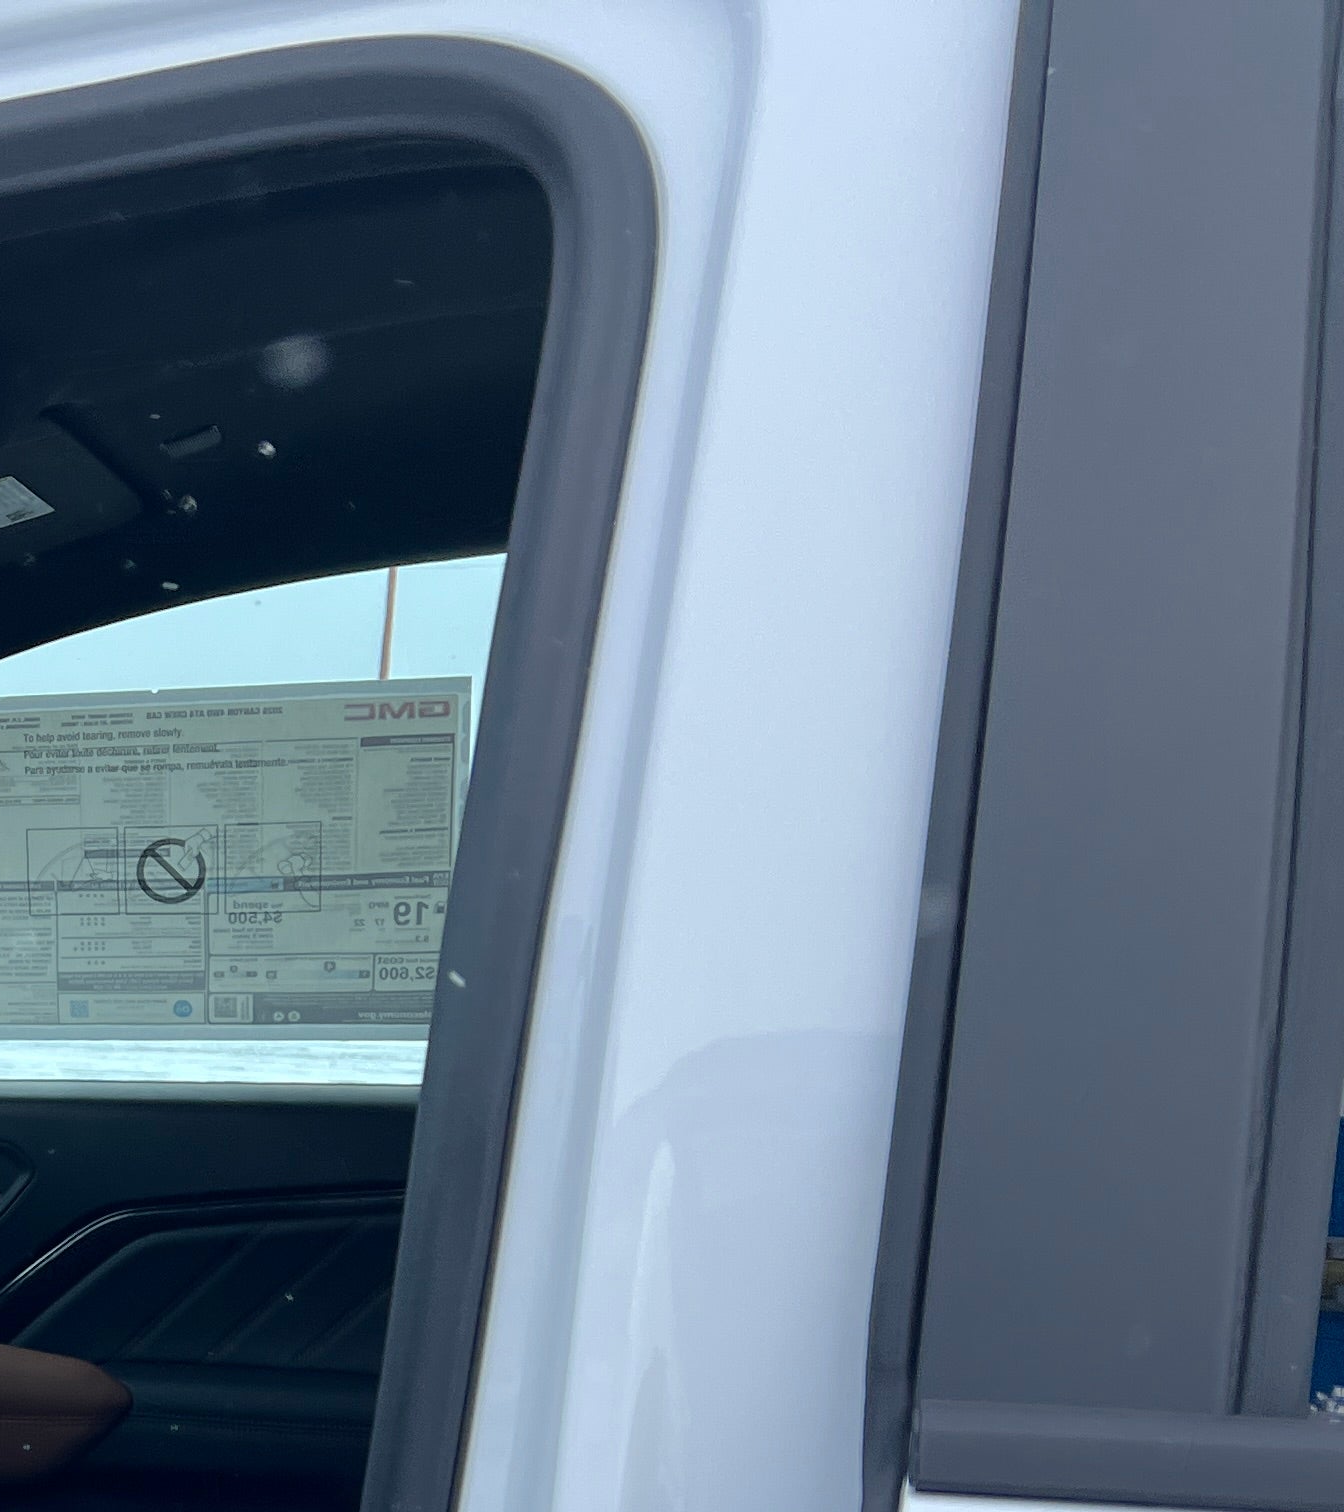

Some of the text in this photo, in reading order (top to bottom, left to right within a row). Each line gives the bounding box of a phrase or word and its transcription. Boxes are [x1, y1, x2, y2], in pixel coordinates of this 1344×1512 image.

[23, 733, 34, 743] To
[36, 732, 55, 744] help
[57, 731, 80, 742] avoid
[83, 731, 116, 741] tearing,
[118, 730, 151, 739] remove
